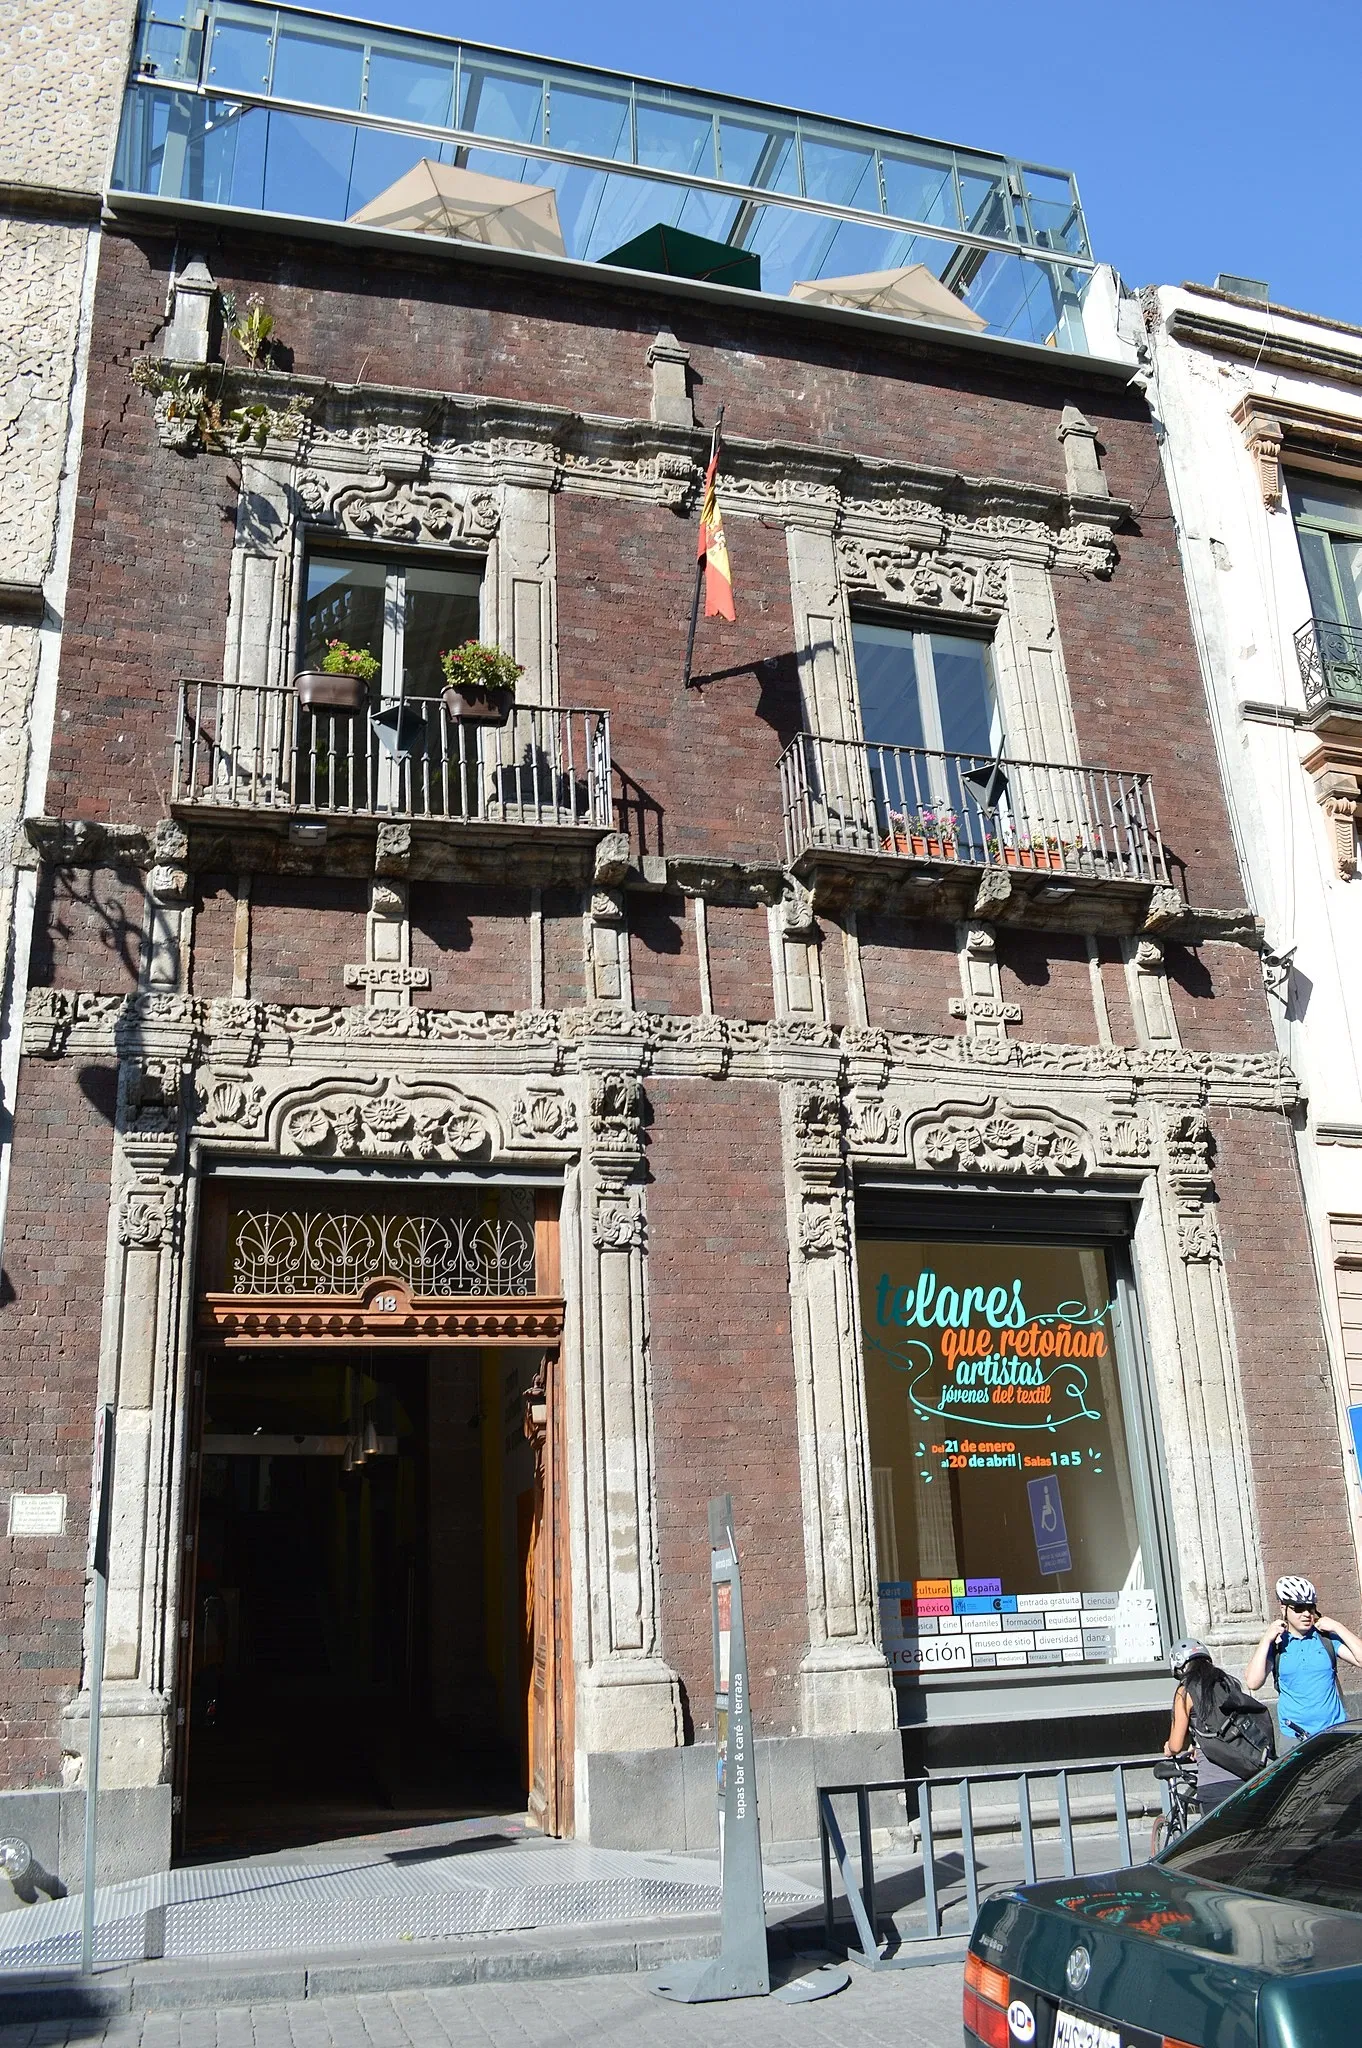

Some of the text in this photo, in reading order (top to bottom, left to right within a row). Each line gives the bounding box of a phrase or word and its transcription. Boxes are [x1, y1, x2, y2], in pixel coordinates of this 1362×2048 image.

[375, 1295, 397, 1312] 18
[875, 1267, 1027, 1328] telares
[941, 1322, 1108, 1370] que retoñan
[955, 1353, 1045, 1386] artistas
[937, 1384, 1051, 1411] jóvenes del textil
[931, 1440, 1016, 1453] Del 21 de enero
[941, 1451, 1082, 1468] al 20 de abril Salas 1 a 5
[953, 1585, 963, 1594] de
[967, 1584, 1000, 1595] españa
[917, 1602, 950, 1613] méxico
[1019, 1597, 1080, 1608] entrada gratuita
[1087, 1597, 1115, 1606] ciencias
[942, 1621, 958, 1629] cine
[964, 1619, 999, 1628] infantiles
[1006, 1617, 1043, 1627] formación
[1048, 1615, 1077, 1625] equidad
[1003, 1638, 1013, 1646] de
[1014, 1637, 1031, 1645] sitio
[1039, 1634, 1079, 1644] diversidad
[733, 1673, 747, 1820] tapas bar & café terraza
[978, 1933, 1004, 1952] Jetta
[1016, 2007, 1026, 2029] D
